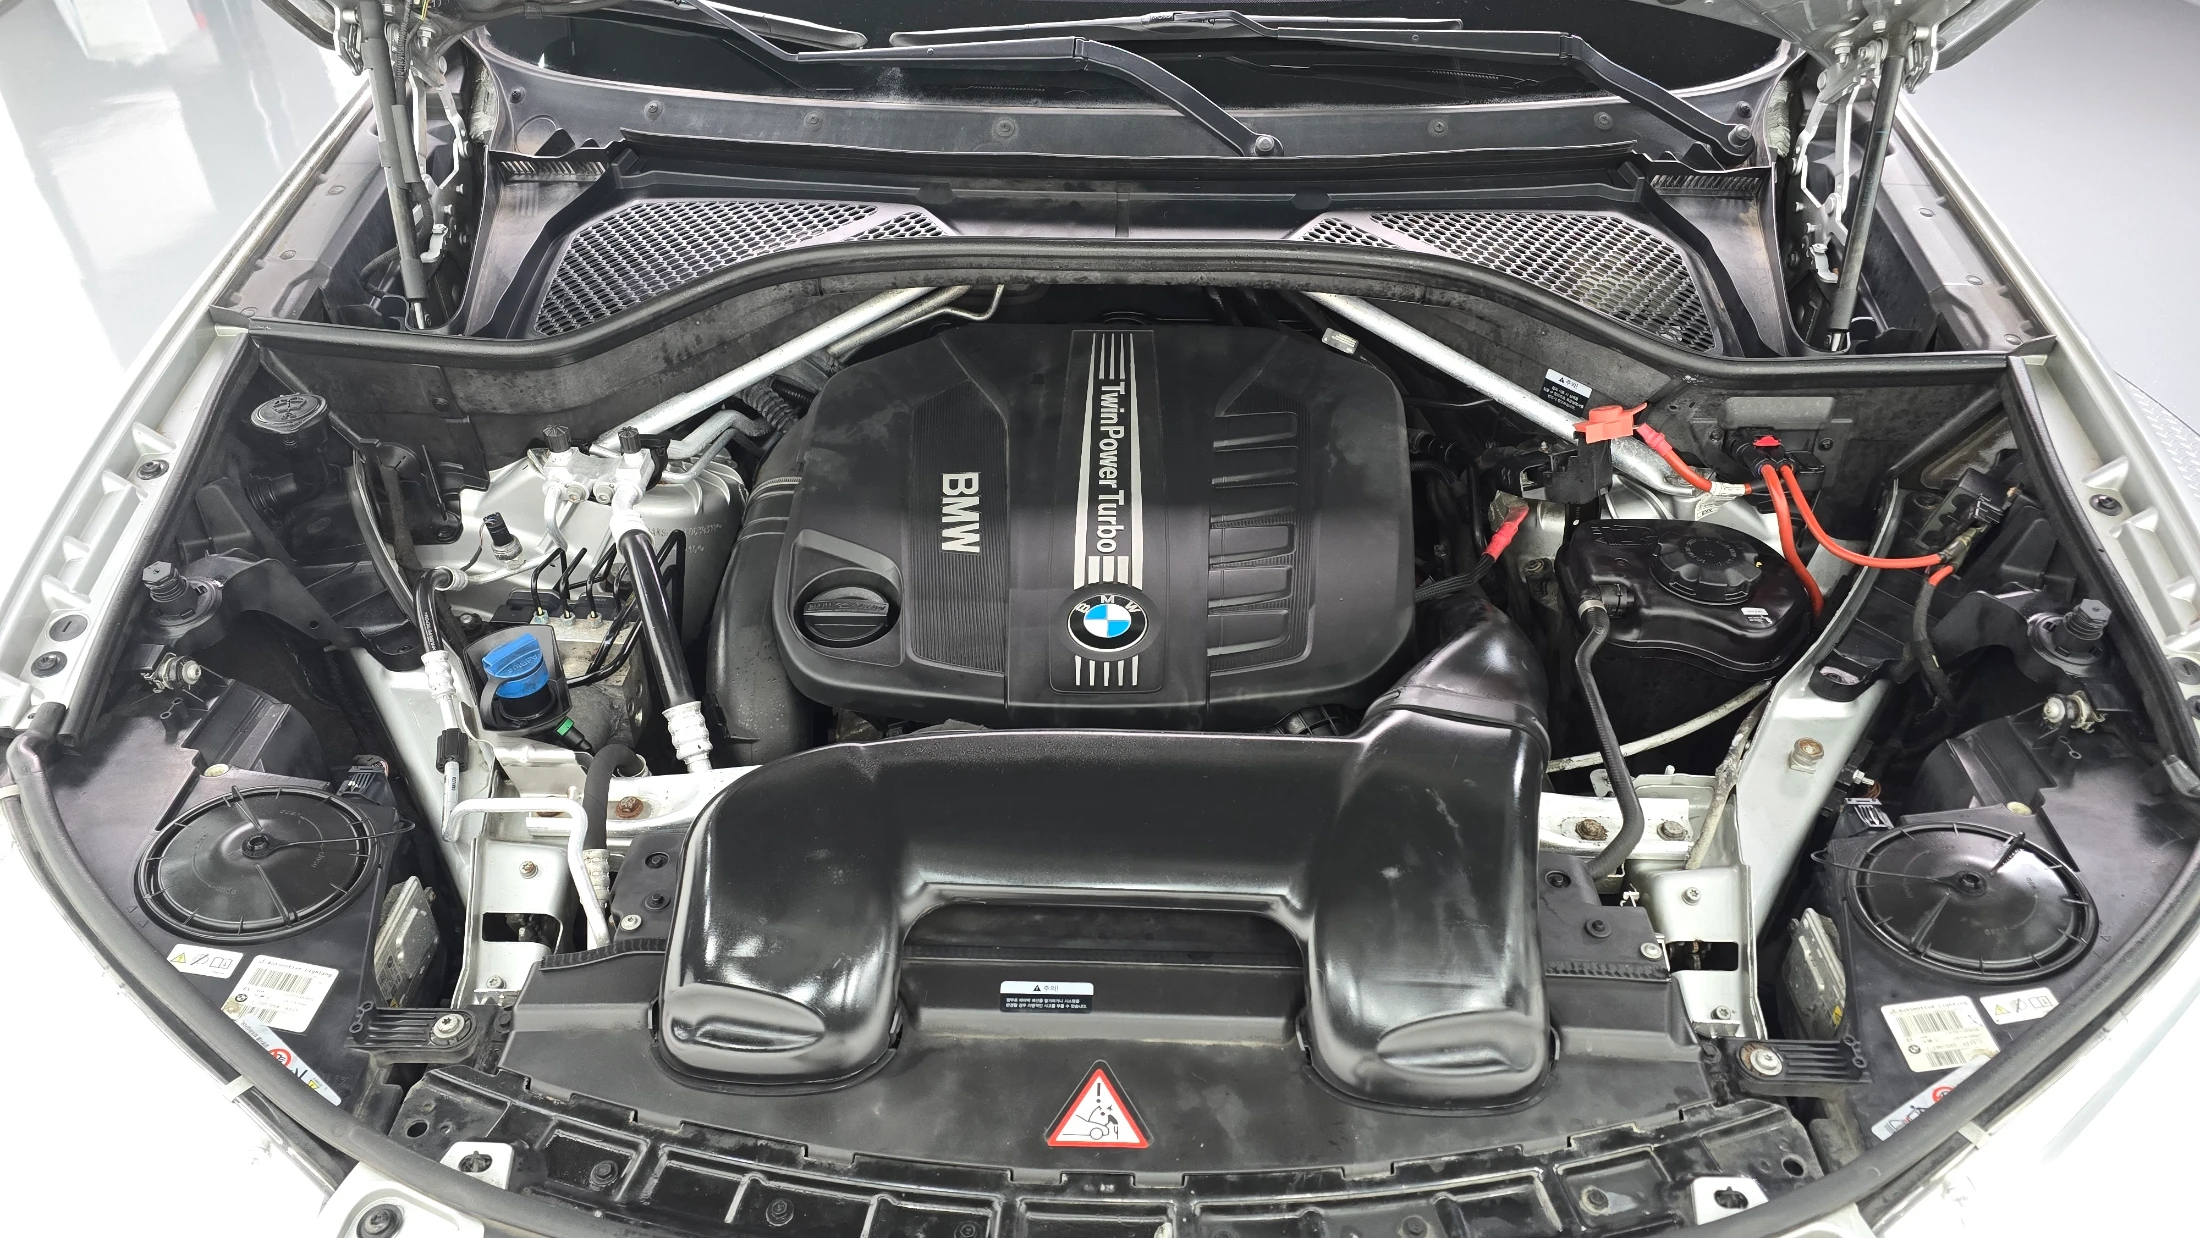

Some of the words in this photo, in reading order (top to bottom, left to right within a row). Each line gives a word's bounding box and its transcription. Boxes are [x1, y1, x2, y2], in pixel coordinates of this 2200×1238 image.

[1097, 381, 1125, 489] TwinPower
[941, 472, 981, 554] BMW
[1096, 490, 1124, 553] Turbo
[1075, 594, 1142, 614] BMW
